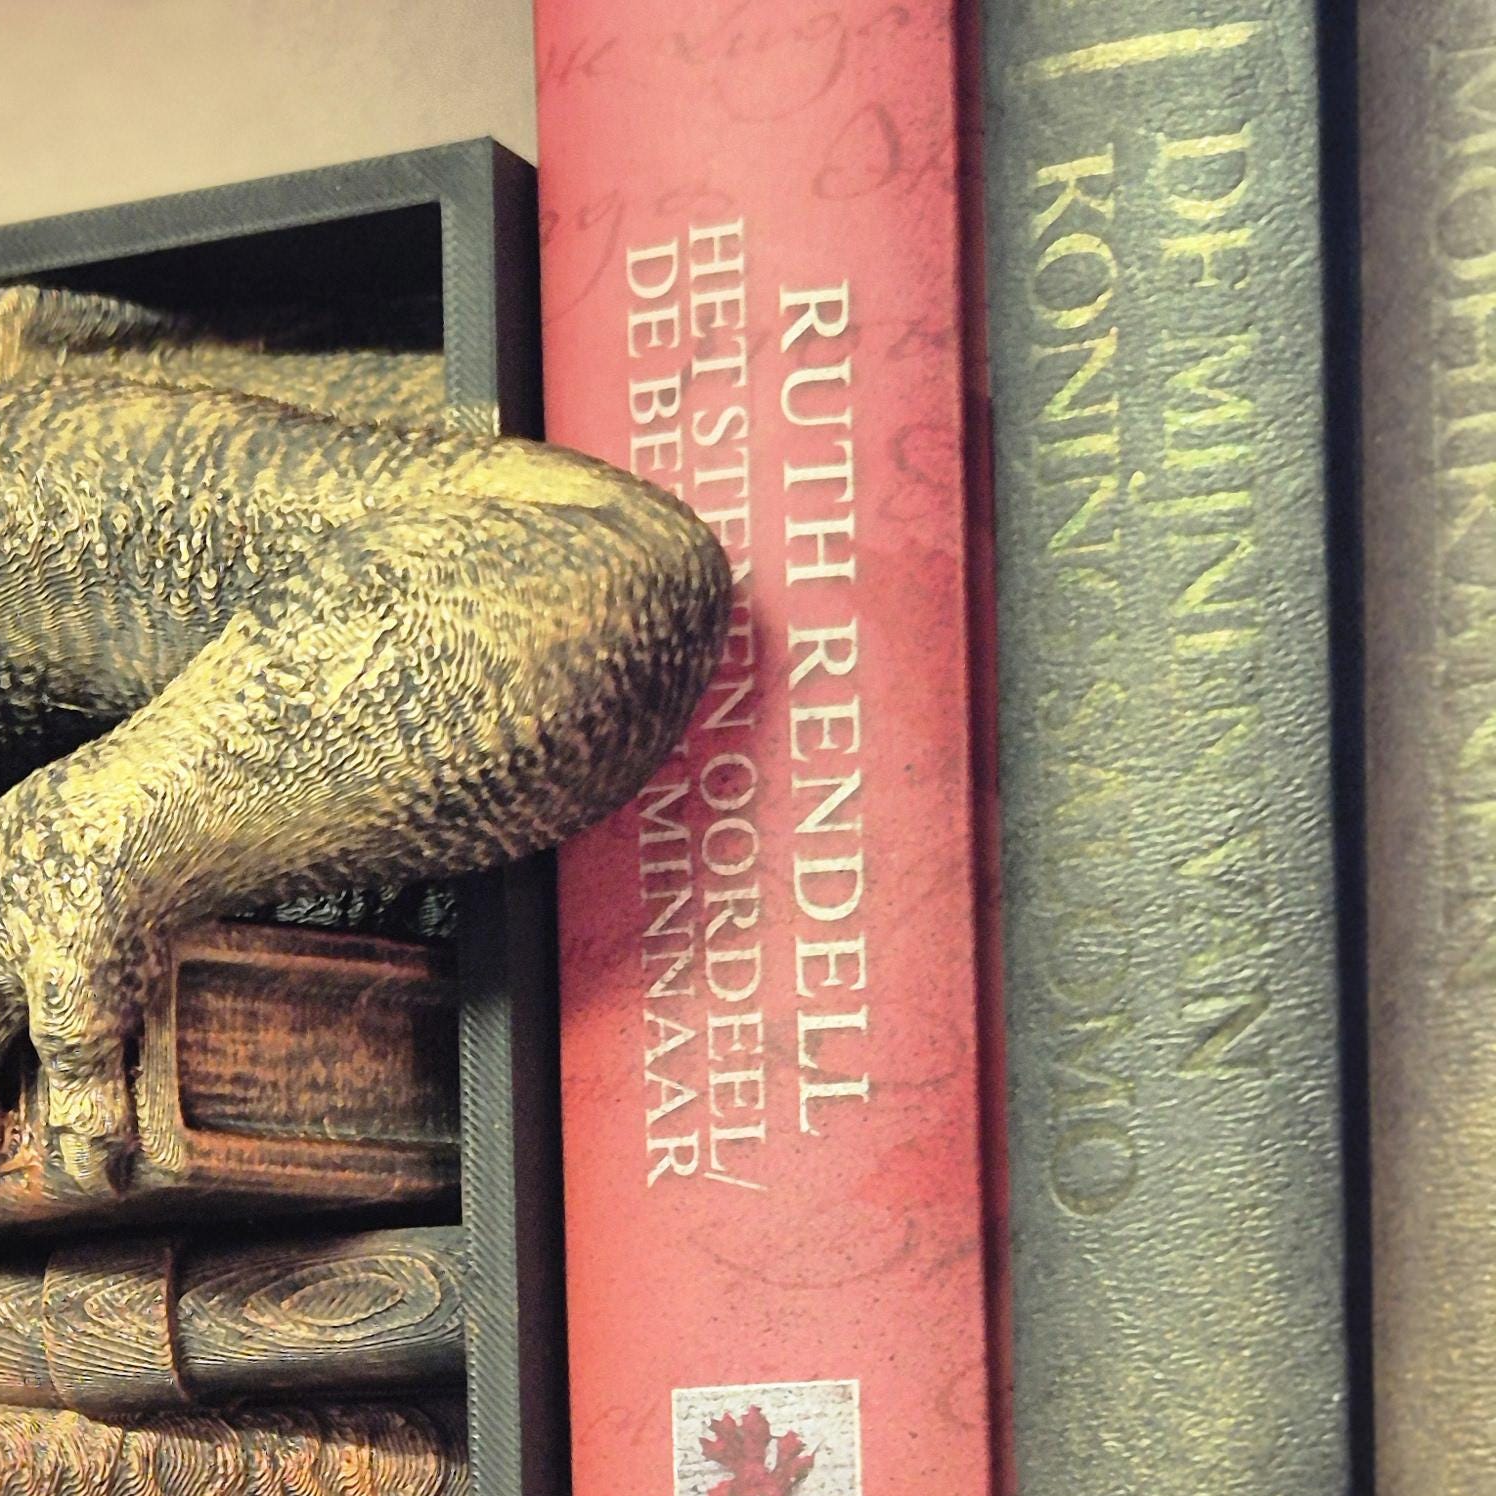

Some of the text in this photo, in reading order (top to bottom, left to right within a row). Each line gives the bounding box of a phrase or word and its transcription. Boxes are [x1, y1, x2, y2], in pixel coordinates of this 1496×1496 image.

[626, 237, 681, 359] DE
[689, 216, 747, 388] HET
[779, 279, 871, 1136] RUTH RENDELL
[637, 777, 701, 1190] MINNAAR
